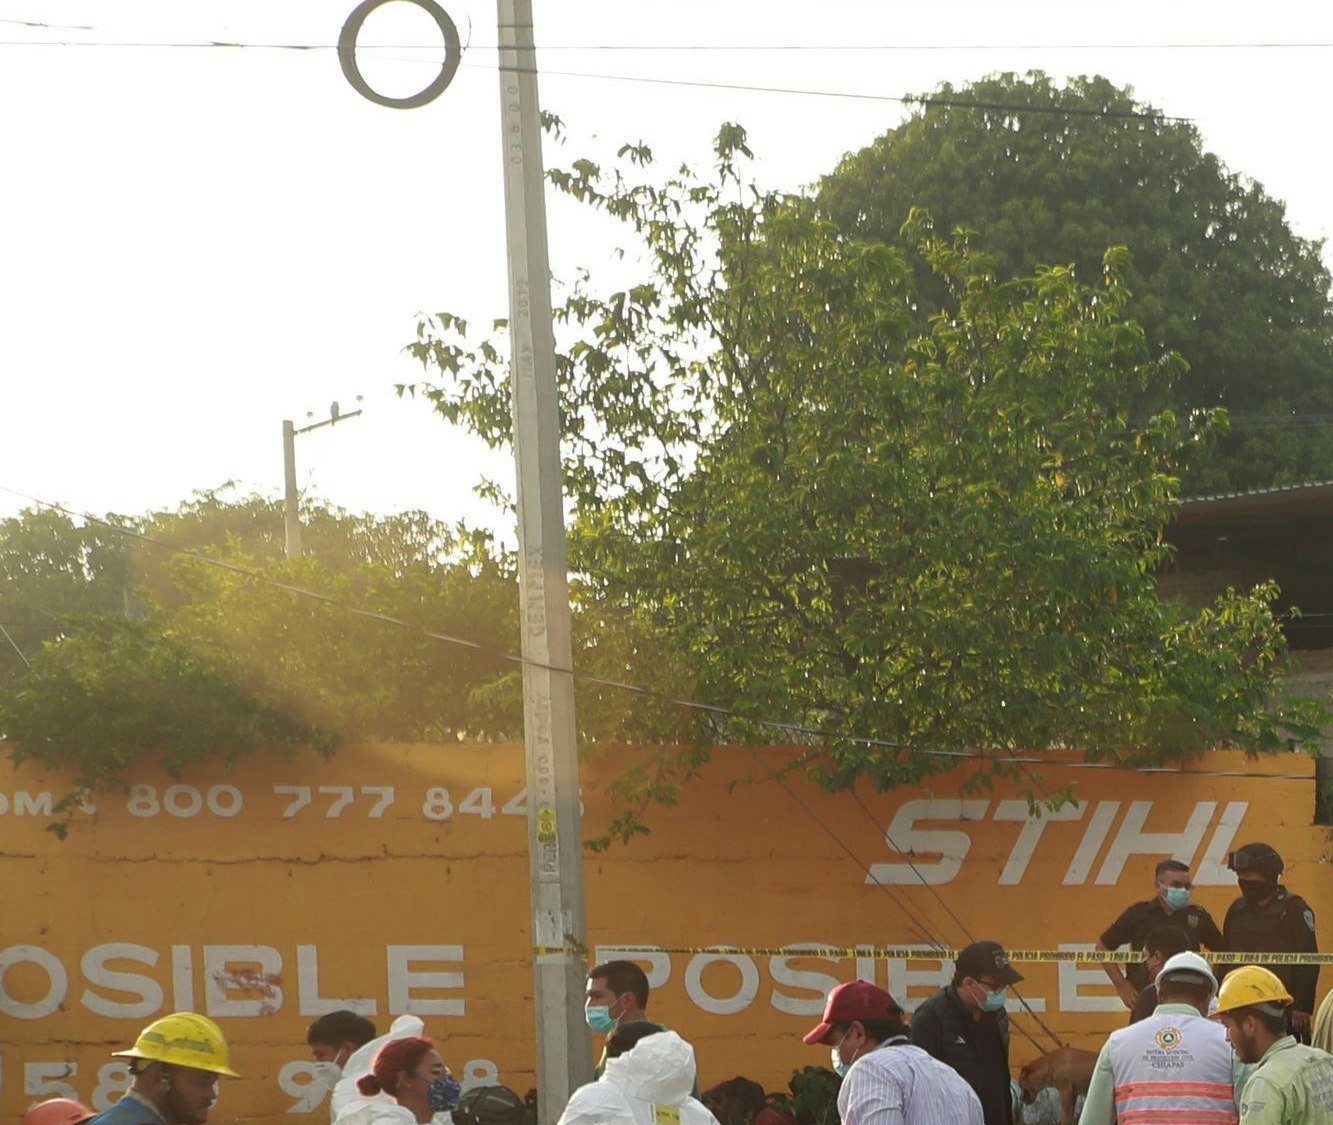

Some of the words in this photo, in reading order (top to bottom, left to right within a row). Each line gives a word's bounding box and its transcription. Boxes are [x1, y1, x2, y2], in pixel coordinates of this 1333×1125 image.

[127, 783, 244, 818] 800
[273, 785, 395, 819] 777
[864, 799, 1248, 886] STIHL
